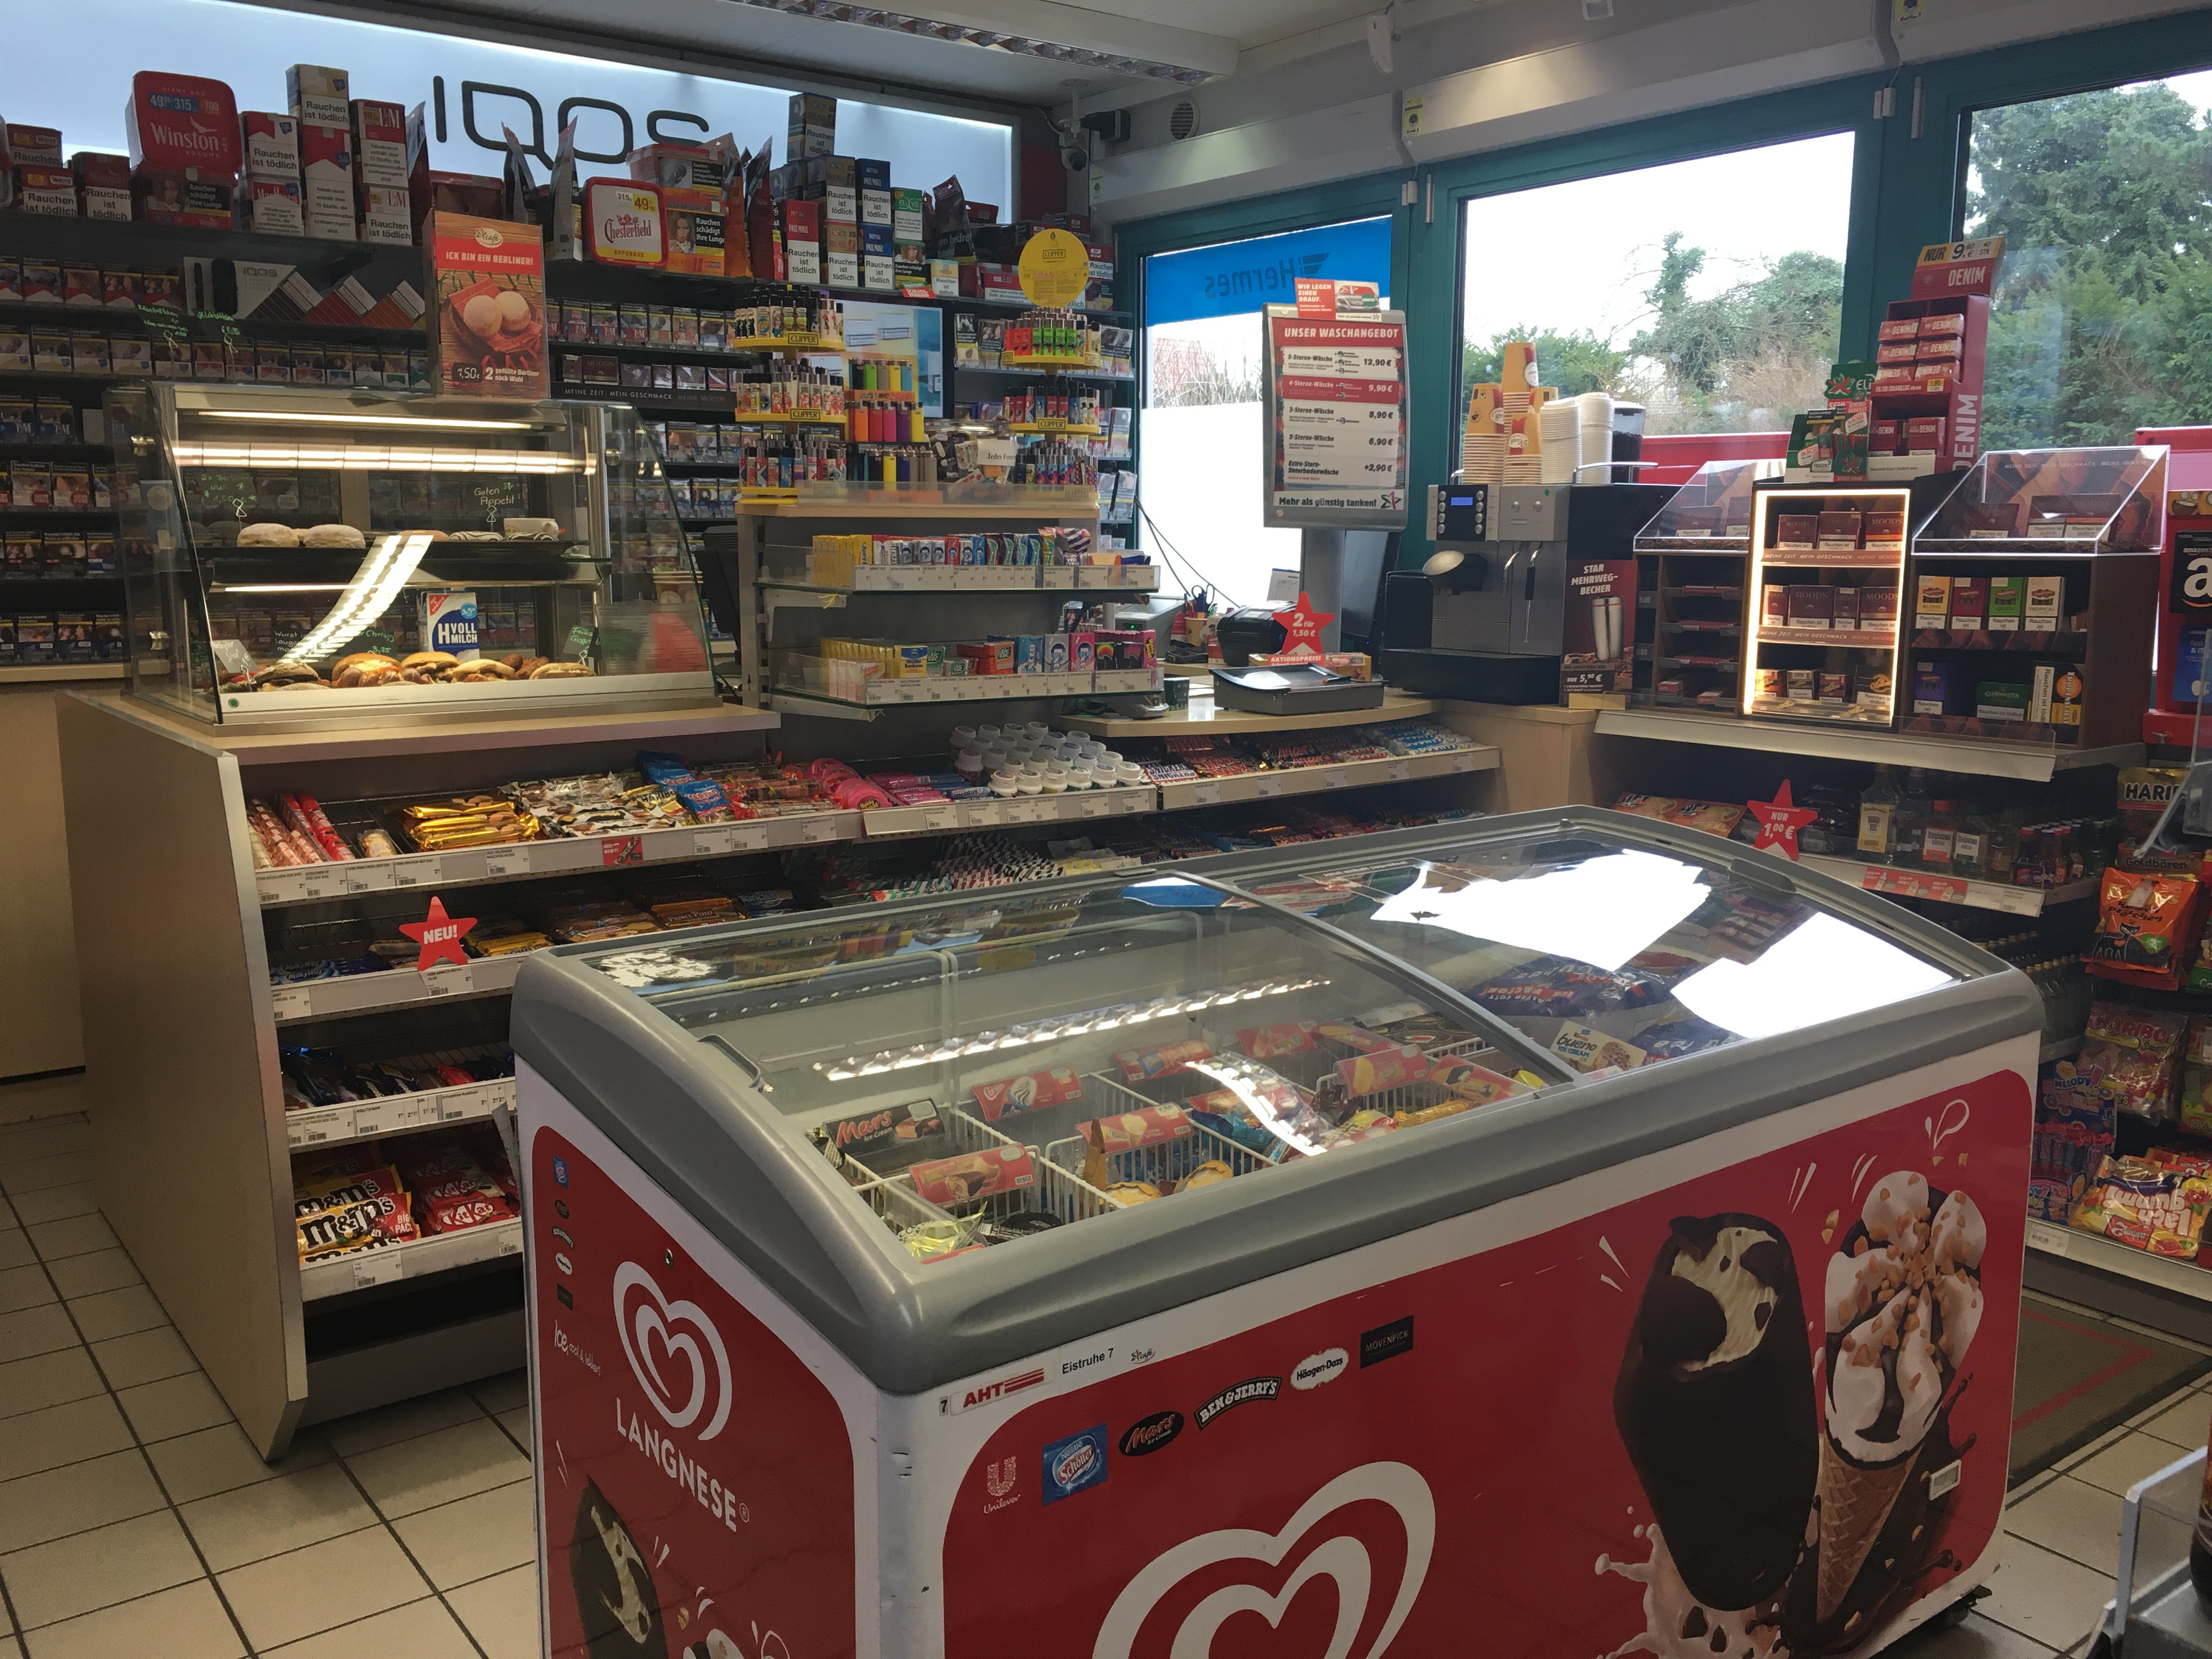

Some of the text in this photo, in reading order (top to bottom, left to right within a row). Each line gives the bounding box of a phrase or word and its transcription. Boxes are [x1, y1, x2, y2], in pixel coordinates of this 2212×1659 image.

[306, 101, 346, 113] Rauchen
[318, 112, 348, 123] tödlich
[433, 75, 709, 170] IQOS
[150, 122, 219, 151] Winston
[14, 151, 59, 165] Rauchen
[253, 148, 295, 160] Rauchen
[266, 159, 297, 170] tödlich
[28, 193, 74, 206] Rauchen
[86, 188, 131, 201] Rauchen
[828, 190, 856, 200] Rauchen
[864, 194, 891, 204] Rauchen
[104, 200, 116, 208] ist
[42, 205, 77, 216] tödlich
[93, 208, 127, 220] tödlich
[831, 207, 853, 216] tödlich
[867, 211, 888, 219] tödlich
[370, 219, 408, 230] Rauchen
[696, 217, 721, 227] Rauchen
[382, 230, 411, 240] tödlich
[604, 218, 652, 244] Chesterfield
[696, 226, 721, 235] schädigt
[696, 234, 725, 244] Ihre Lunge
[445, 251, 534, 266] ICK BIN EIN BERLINER!
[614, 249, 644, 258] SUPERBOX
[788, 248, 820, 258] Rauchen
[1923, 247, 1947, 262] NUR
[829, 257, 856, 266] Rauchen
[866, 260, 892, 269] Rauchen
[792, 266, 816, 274] tödlich
[833, 273, 855, 281] tödlich
[869, 276, 890, 284] tödlich
[1948, 266, 1987, 287] DENIM
[1892, 324, 1912, 335] DENIM
[1932, 320, 1953, 330] DENIM
[1284, 328, 1398, 338] UNSER WASCHANGEBOT
[790, 335, 816, 343] CLIPPER
[1890, 347, 1910, 357] DENIM
[1930, 342, 1950, 353] DENIM
[1288, 354, 1385, 367] 5-Sterne-Wäsche 12,90
[484, 366, 494, 380] 2
[517, 369, 540, 377] Berliner
[1289, 380, 1334, 388] 4-Sterne-Wäsche
[793, 410, 819, 418] CLIPPER
[1289, 407, 1387, 419] 3-Sterne-Wäsche 8,90
[1878, 425, 1894, 435] DENIM
[1918, 424, 1936, 433] DENIM
[1951, 393, 1978, 471] DENIM
[1289, 434, 1387, 446] 2-Sterne-Wäsche 6,90
[1288, 467, 1339, 476] Unterbodenwäsche
[473, 487, 500, 496] Guten
[480, 495, 515, 506] Appetit
[1279, 497, 1377, 507] Mehr als tanken!
[1583, 564, 1605, 574] STAR
[1571, 573, 1618, 586] MEHRWEG-
[1579, 584, 1611, 595] BECHER
[1795, 591, 1828, 599] MOODS
[1865, 592, 1898, 601] MOODS
[1292, 612, 1305, 627] 2
[450, 622, 477, 634] VOLL
[1292, 629, 1309, 637] 1,50
[450, 634, 478, 644] MILCH
[1271, 655, 1322, 663] AKTIONSPREIS!
[2042, 668, 2051, 698] Rauchen
[1984, 691, 2020, 699] CLUBMASTER
[1152, 771, 1195, 781] SNICKERS
[953, 789, 978, 798] mentos
[1770, 811, 1788, 822] NUR
[1784, 825, 1796, 839] €
[2125, 857, 2187, 870] Goldbären
[668, 910, 713, 922] PRINCE POLO
[422, 924, 458, 945] NEU!
[2091, 1015, 2168, 1043] HARIBO
[1556, 1032, 1597, 1052] bueno
[1567, 1048, 1590, 1058] CREAM
[1462, 1084, 1487, 1092] DOMINO
[2053, 1077, 2092, 1089] MELODY
[836, 1111, 892, 1148] Mars
[864, 1126, 894, 1142] Ice Cream
[2103, 1184, 2186, 1211] gummi
[397, 1214, 410, 1224] BIG
[441, 1201, 494, 1226] KitKat
[2137, 1209, 2191, 1236] lach
[1365, 1329, 1409, 1352] MÖVENPICK
[1062, 1347, 1115, 1375] Eistruhe 7
[1296, 1357, 1344, 1381] Häagen-Dazs
[940, 1381, 1004, 1413] 7 AHT
[1199, 1379, 1278, 1423] BEN & JERRY'S
[1125, 1413, 1176, 1454] Mars
[1147, 1429, 1172, 1445] Ice Cream
[1061, 1441, 1083, 1459] Nestlé
[616, 1396, 738, 1533] LANGNESE
[1059, 1445, 1094, 1484] Schöller
[983, 1494, 1021, 1514] Unilever
